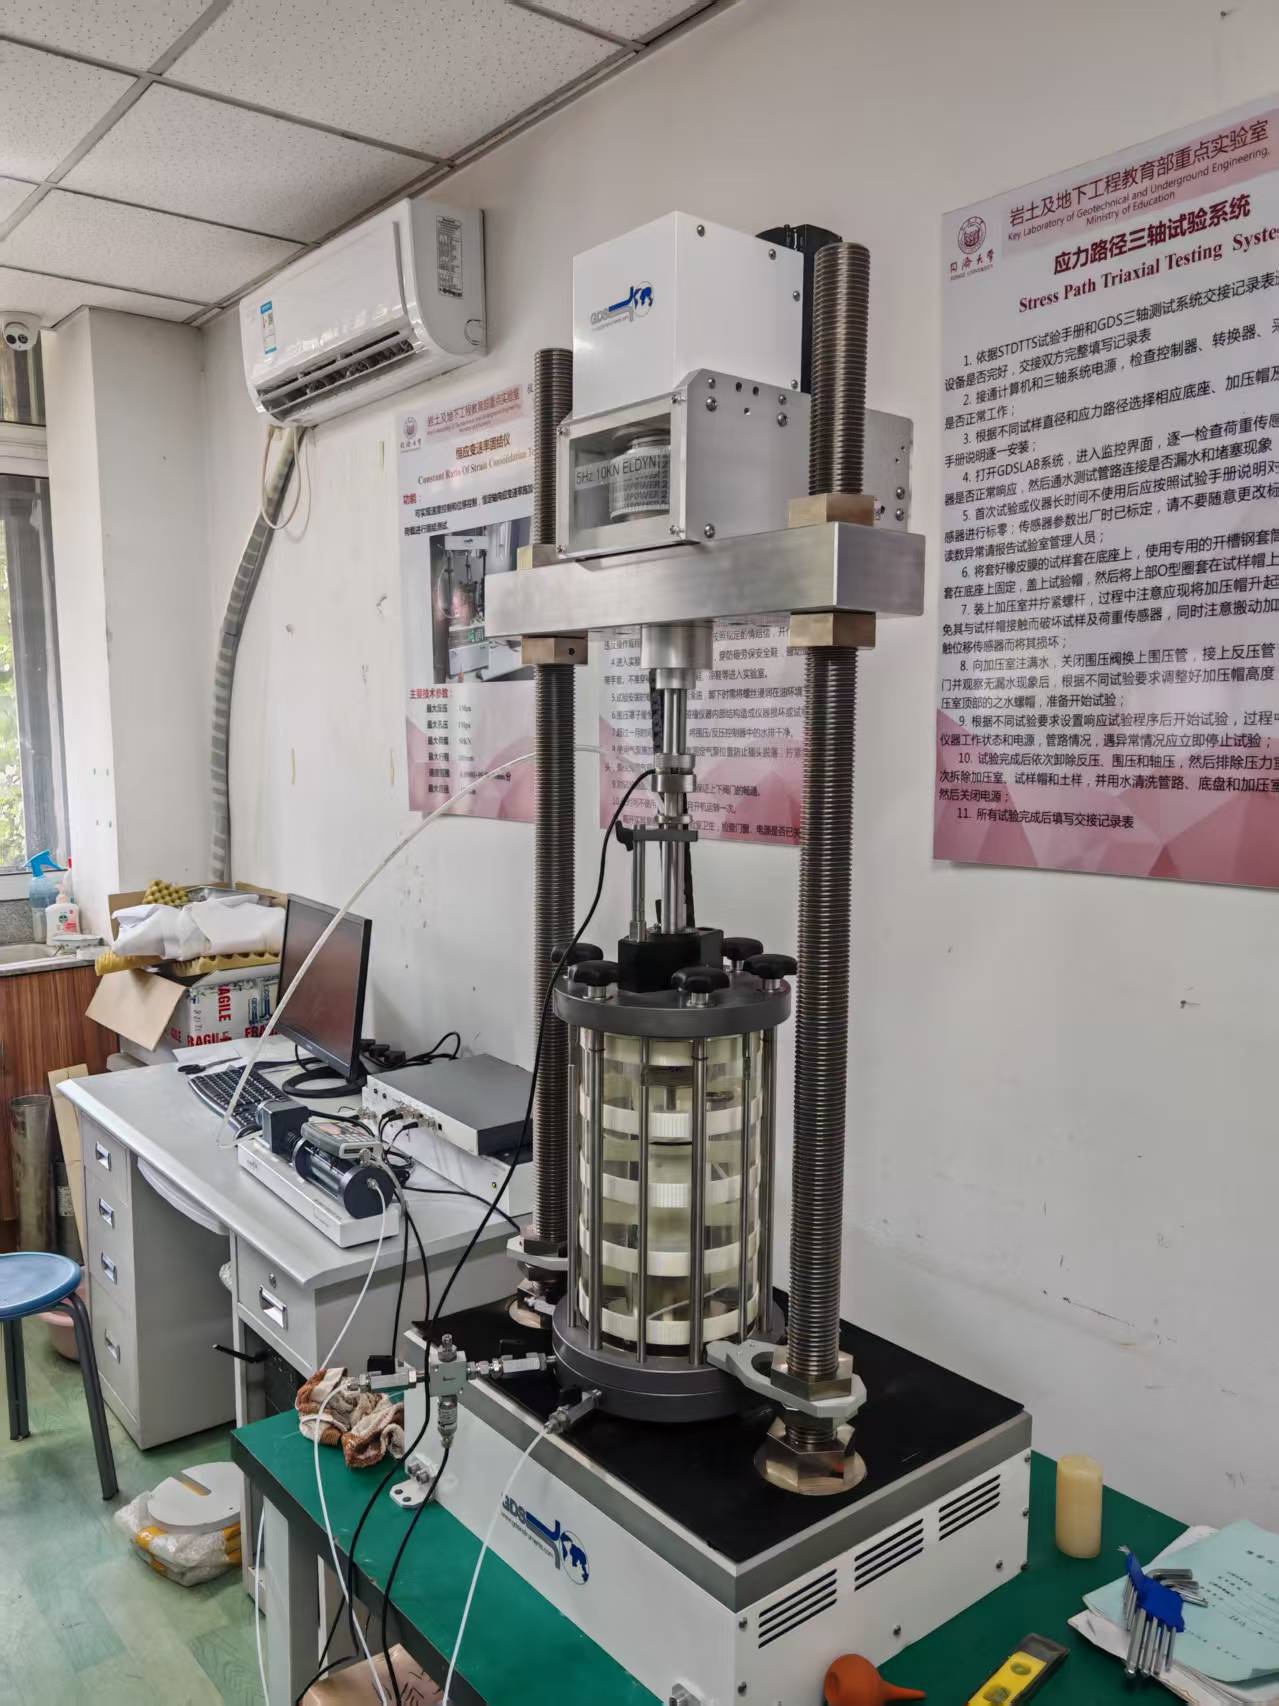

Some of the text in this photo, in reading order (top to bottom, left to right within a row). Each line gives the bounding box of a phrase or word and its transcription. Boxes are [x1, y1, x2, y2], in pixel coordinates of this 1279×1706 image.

[1008, 230, 1021, 242] Key
[1023, 215, 1065, 238] Laboratory
[1066, 213, 1075, 222] of
[1077, 192, 1130, 218] Geotechnical
[1131, 187, 1148, 200] and
[1150, 167, 1209, 195] Underground
[1009, 119, 1269, 228] 岩土及地下工程教育部重点实验室
[1086, 190, 1175, 226] Ministry of Education
[1019, 227, 1279, 313] Stress Path Triaxial Testing Syste
[1053, 193, 1251, 275] 应力路径三轴试验系统
[596, 465, 620, 480] 10KN
